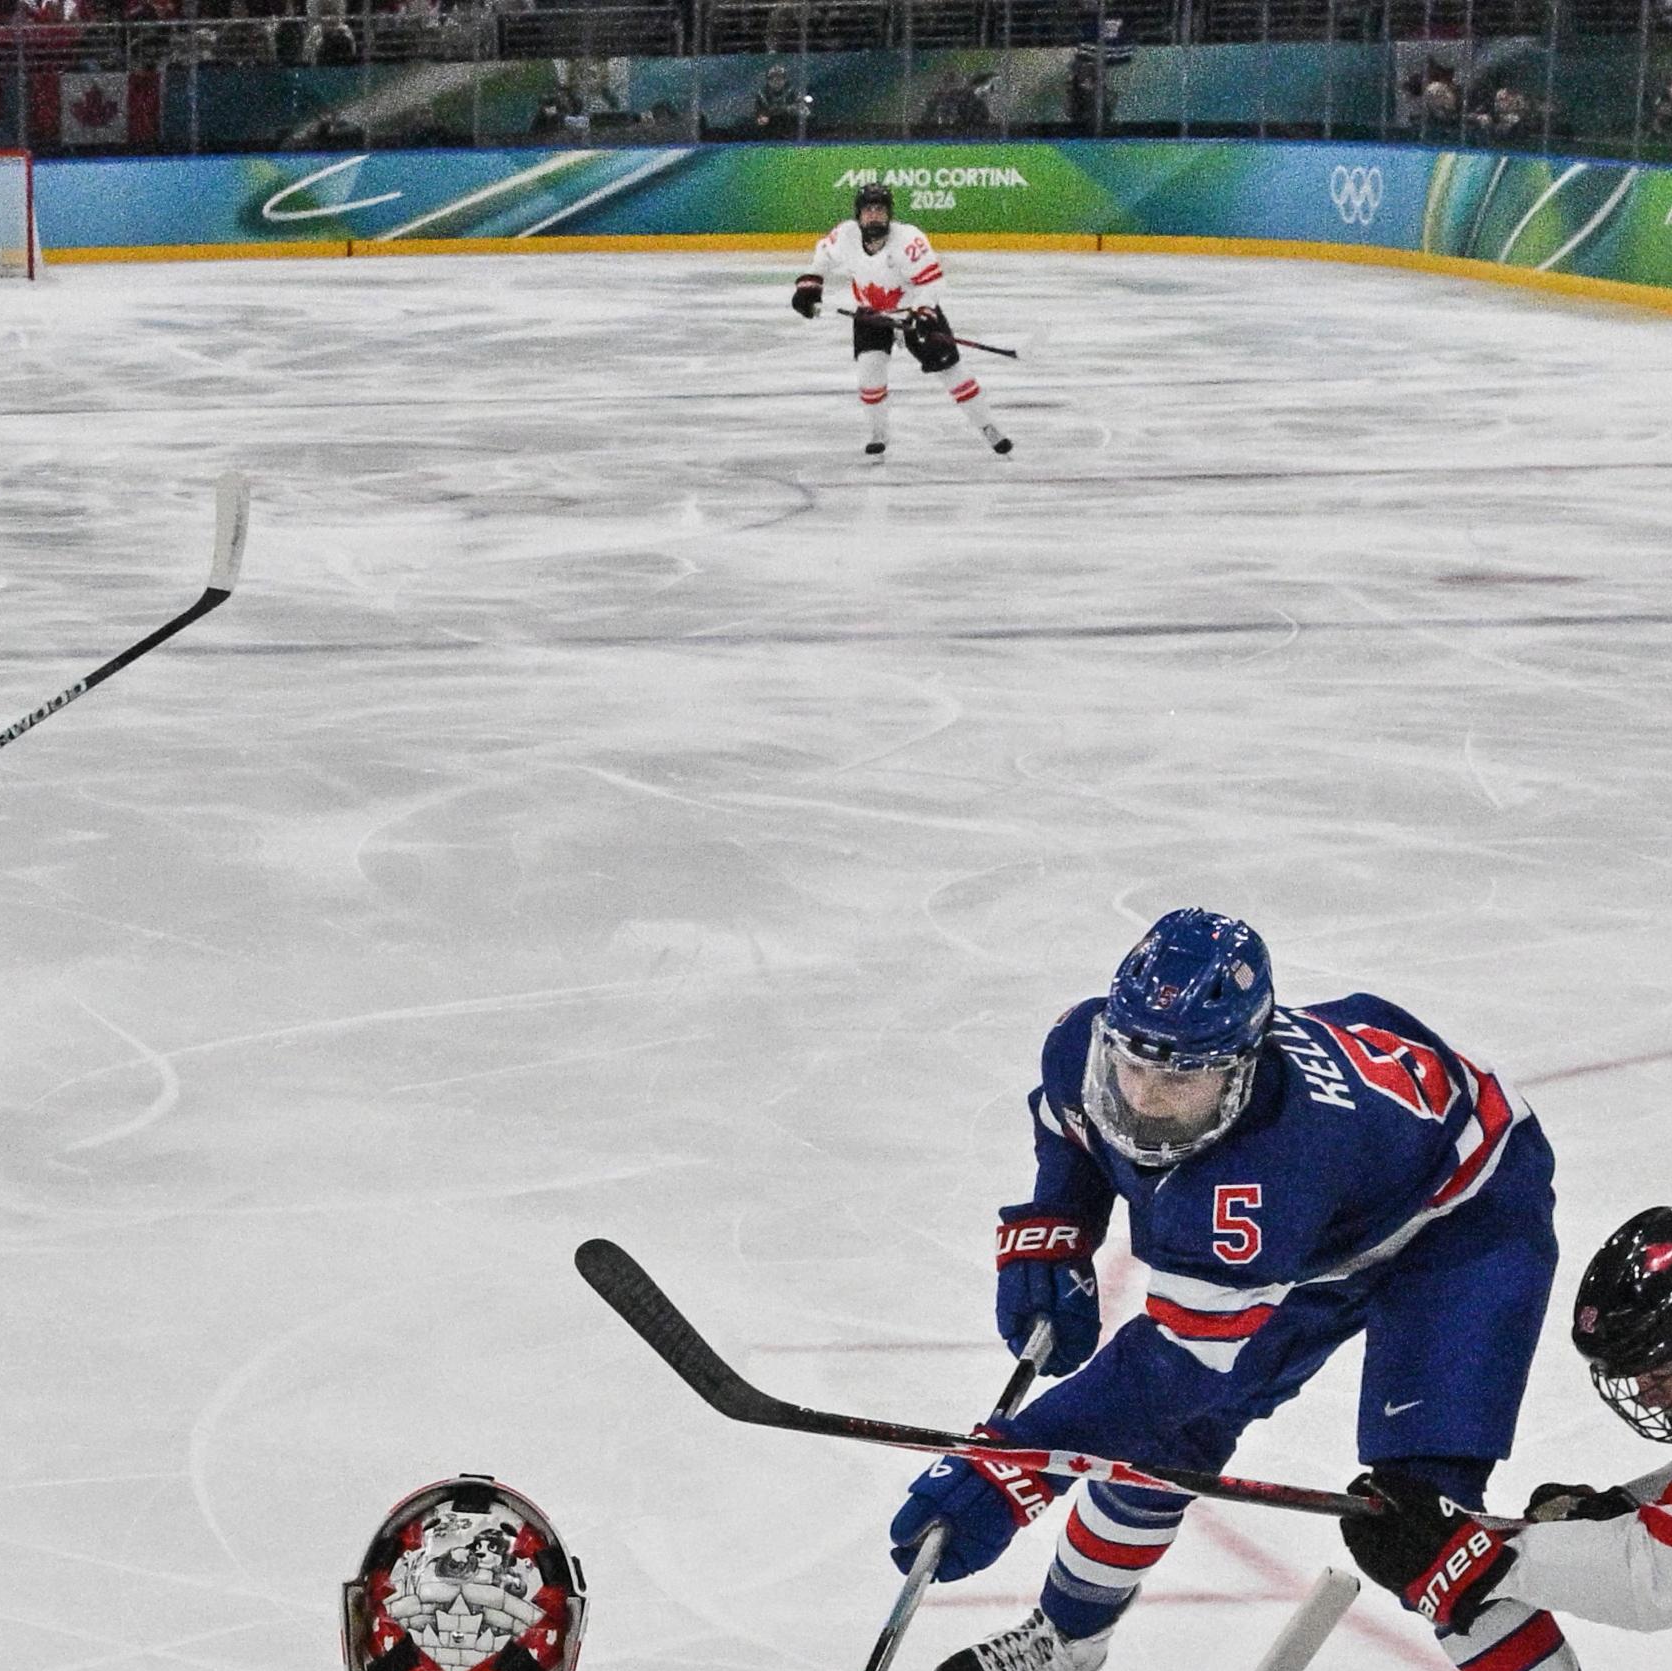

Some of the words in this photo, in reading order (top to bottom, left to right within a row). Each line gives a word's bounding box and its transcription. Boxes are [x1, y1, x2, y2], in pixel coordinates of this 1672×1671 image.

[935, 168, 1029, 187] CORTINA
[911, 190, 957, 209] 2026
[1212, 1184, 1262, 1265] 5
[997, 1225, 1080, 1254] UER
